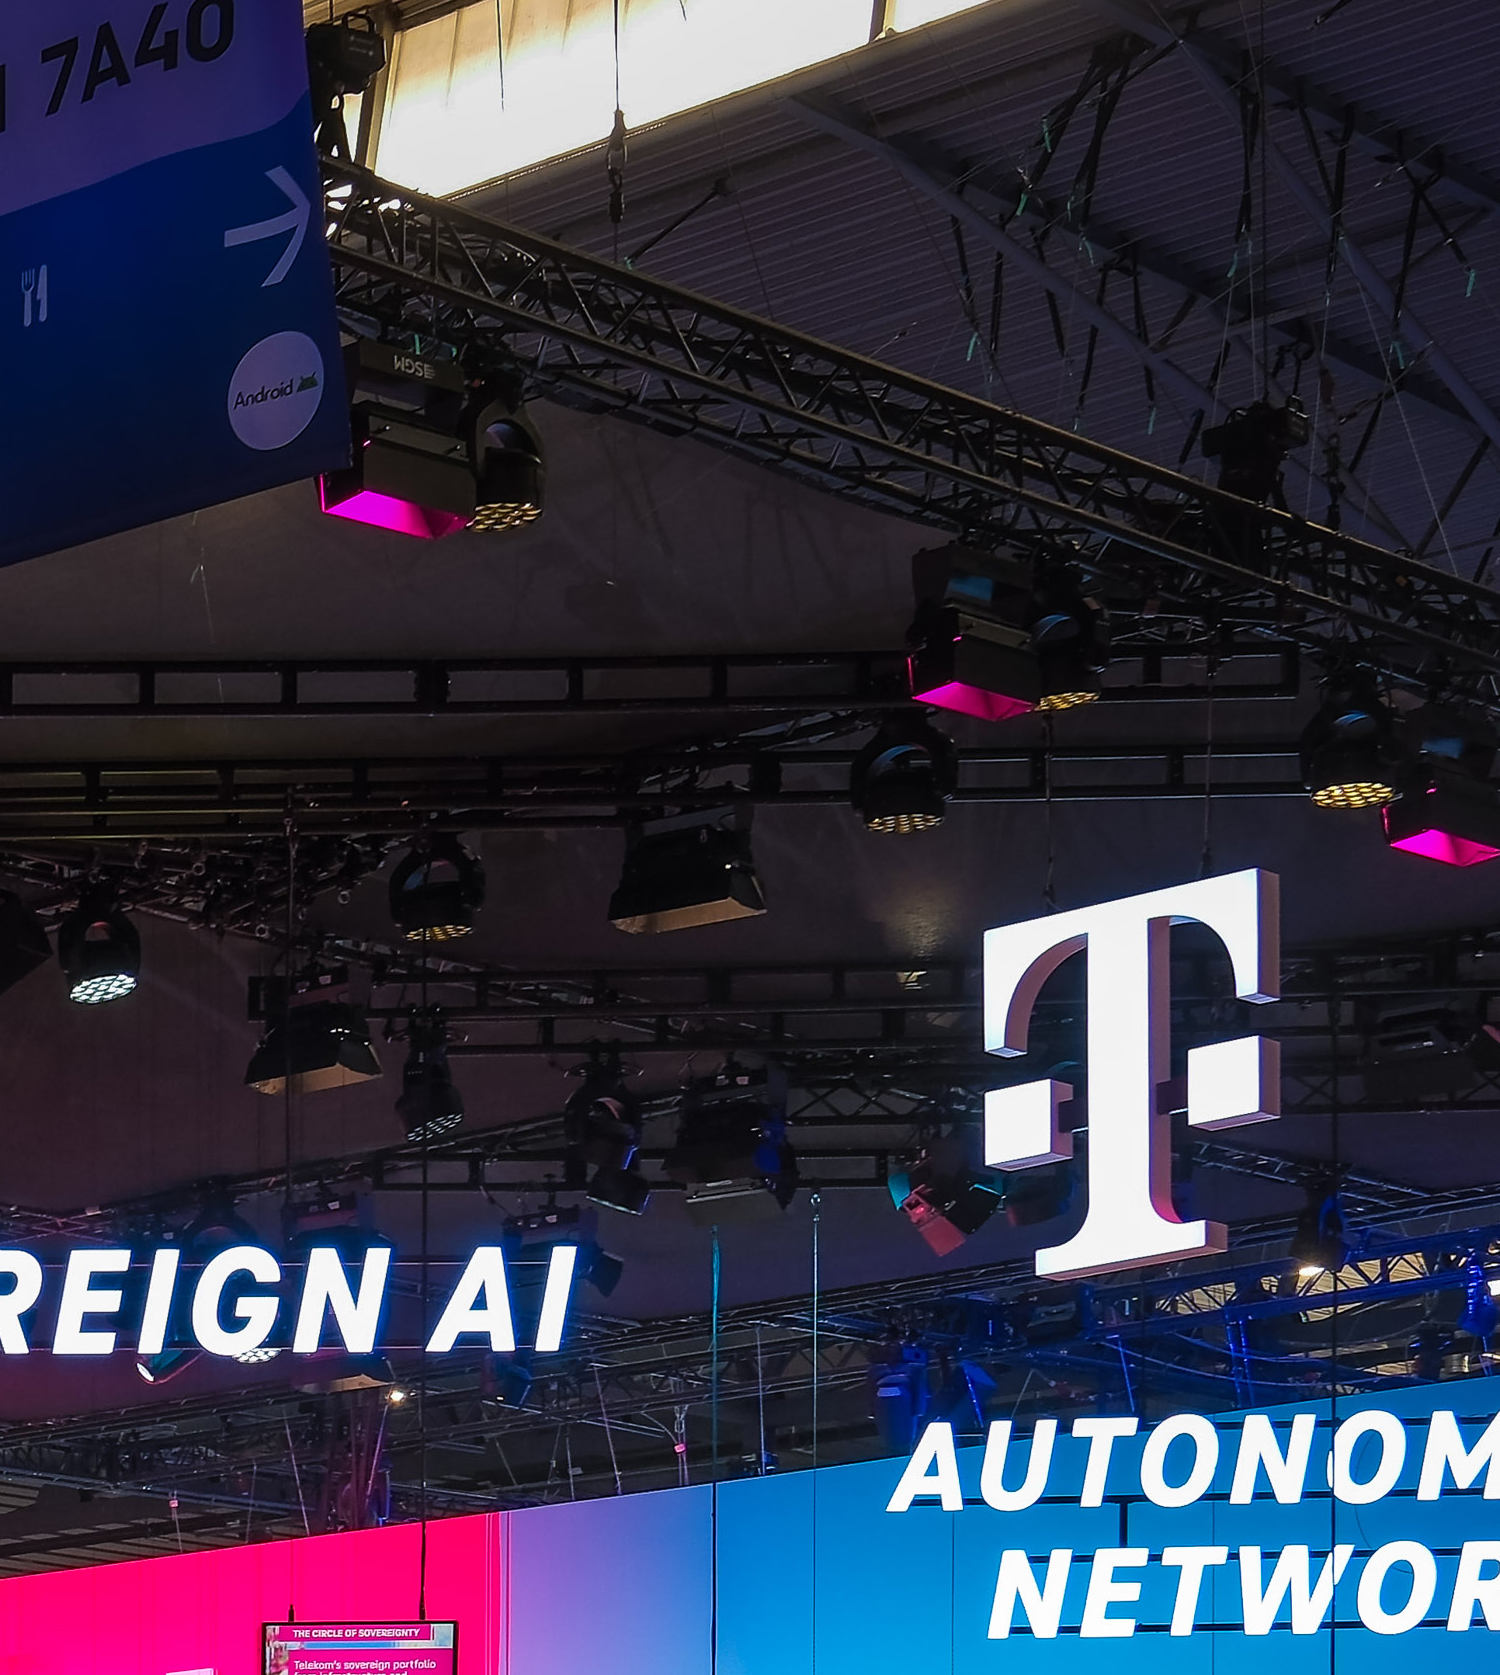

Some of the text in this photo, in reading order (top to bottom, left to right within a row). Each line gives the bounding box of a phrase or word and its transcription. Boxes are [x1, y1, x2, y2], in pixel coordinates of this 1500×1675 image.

[40, 0, 236, 117] 7A40
[233, 378, 293, 410] Android
[425, 1246, 577, 1353] AI
[886, 1410, 1500, 1513] AUTONOM
[292, 1628, 421, 1638] THE CIRCLE OF SOVEREIGNTY
[987, 1540, 1500, 1639] NETWOR
[344, 1659, 390, 1671] sovereign
[392, 1658, 437, 1671] portfolio
